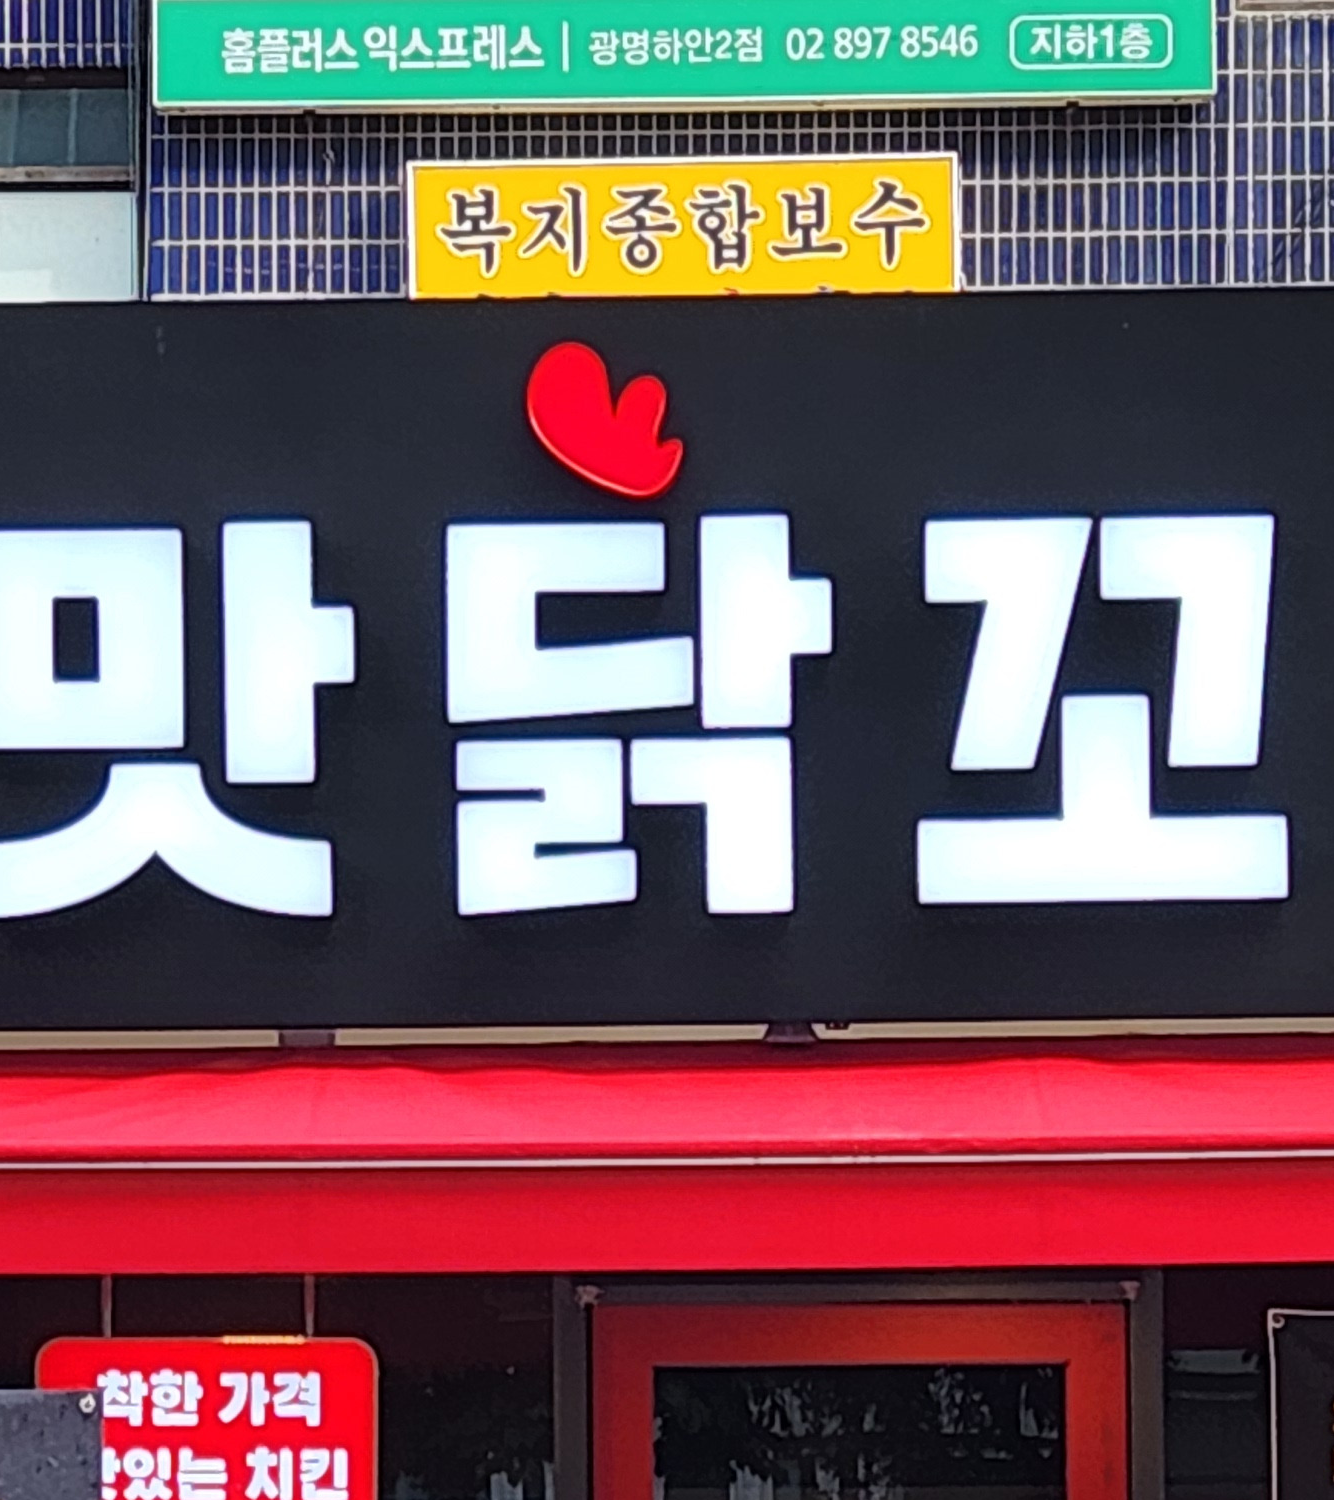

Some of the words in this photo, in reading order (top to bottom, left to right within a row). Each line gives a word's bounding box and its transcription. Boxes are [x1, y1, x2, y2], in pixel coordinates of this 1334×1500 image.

[589, 26, 764, 67] 광명하안2점
[785, 28, 825, 62] 02
[833, 27, 893, 62] 897
[900, 26, 978, 60] 8546
[1030, 20, 1153, 61] 지하1층
[439, 182, 930, 278] 복지종합보수
[96, 1368, 204, 1427] 착한
[218, 1370, 321, 1427] 가격
